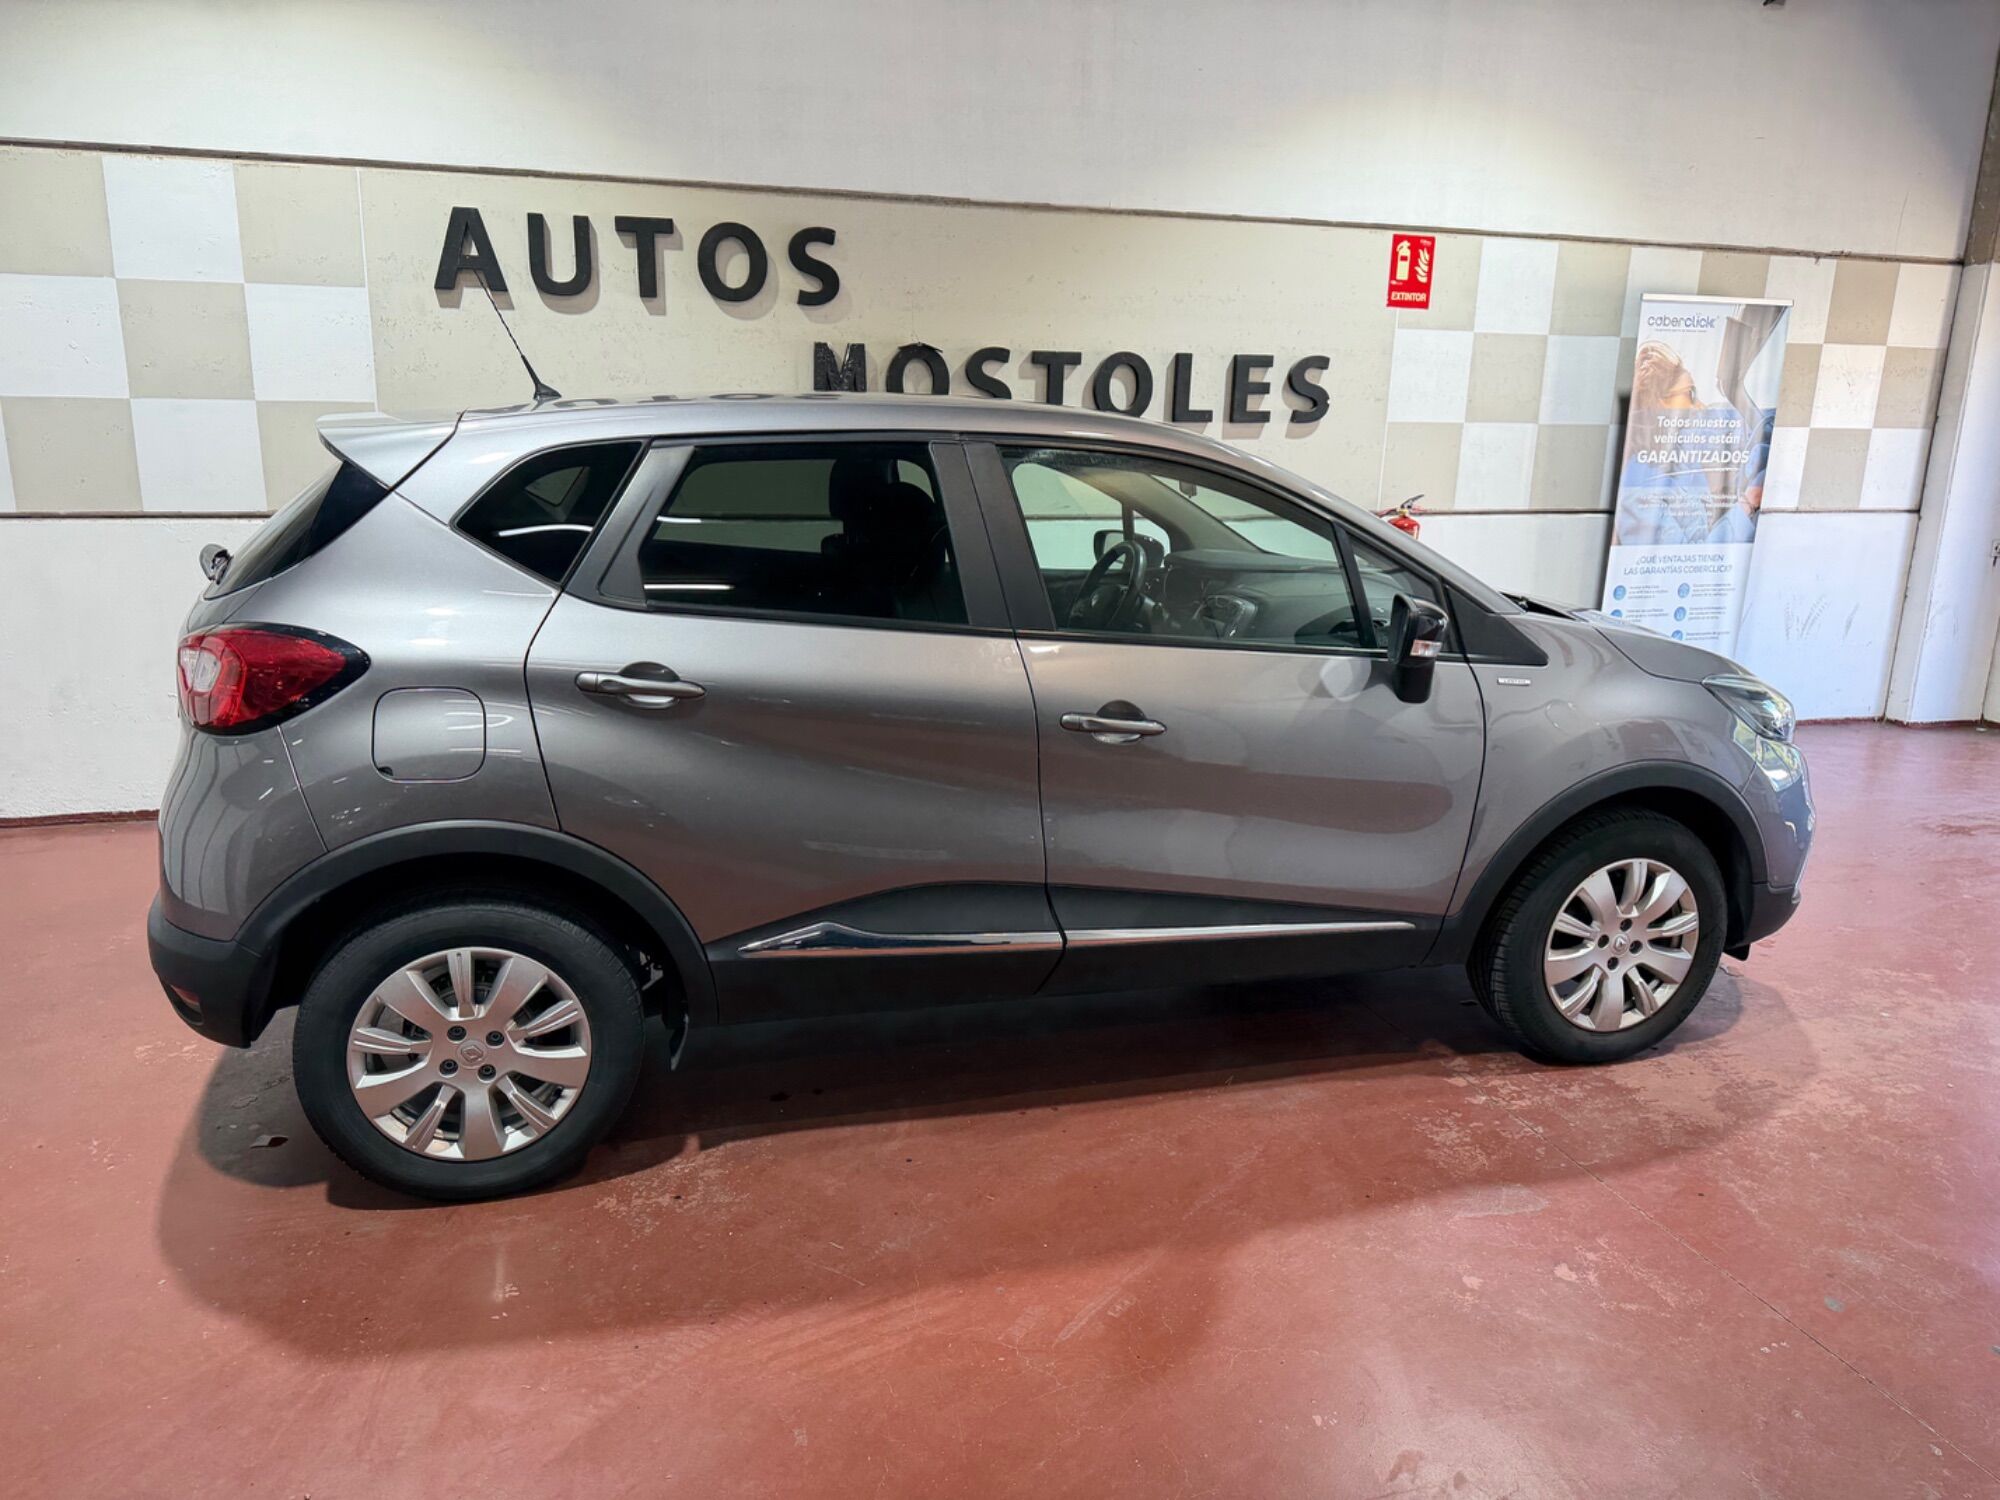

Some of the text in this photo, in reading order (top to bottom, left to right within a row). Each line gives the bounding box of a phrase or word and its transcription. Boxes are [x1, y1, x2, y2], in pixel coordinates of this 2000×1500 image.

[434, 206, 840, 306] AUTOS
[1391, 291, 1427, 302] EXTINTOR
[813, 341, 1330, 424] MOSTOLES
[1657, 416, 1742, 428] Todos nuestros
[1654, 432, 1741, 444] vehículos están
[1637, 450, 1750, 464] GARANTIZADOS
[1623, 567, 1639, 576] LAS
